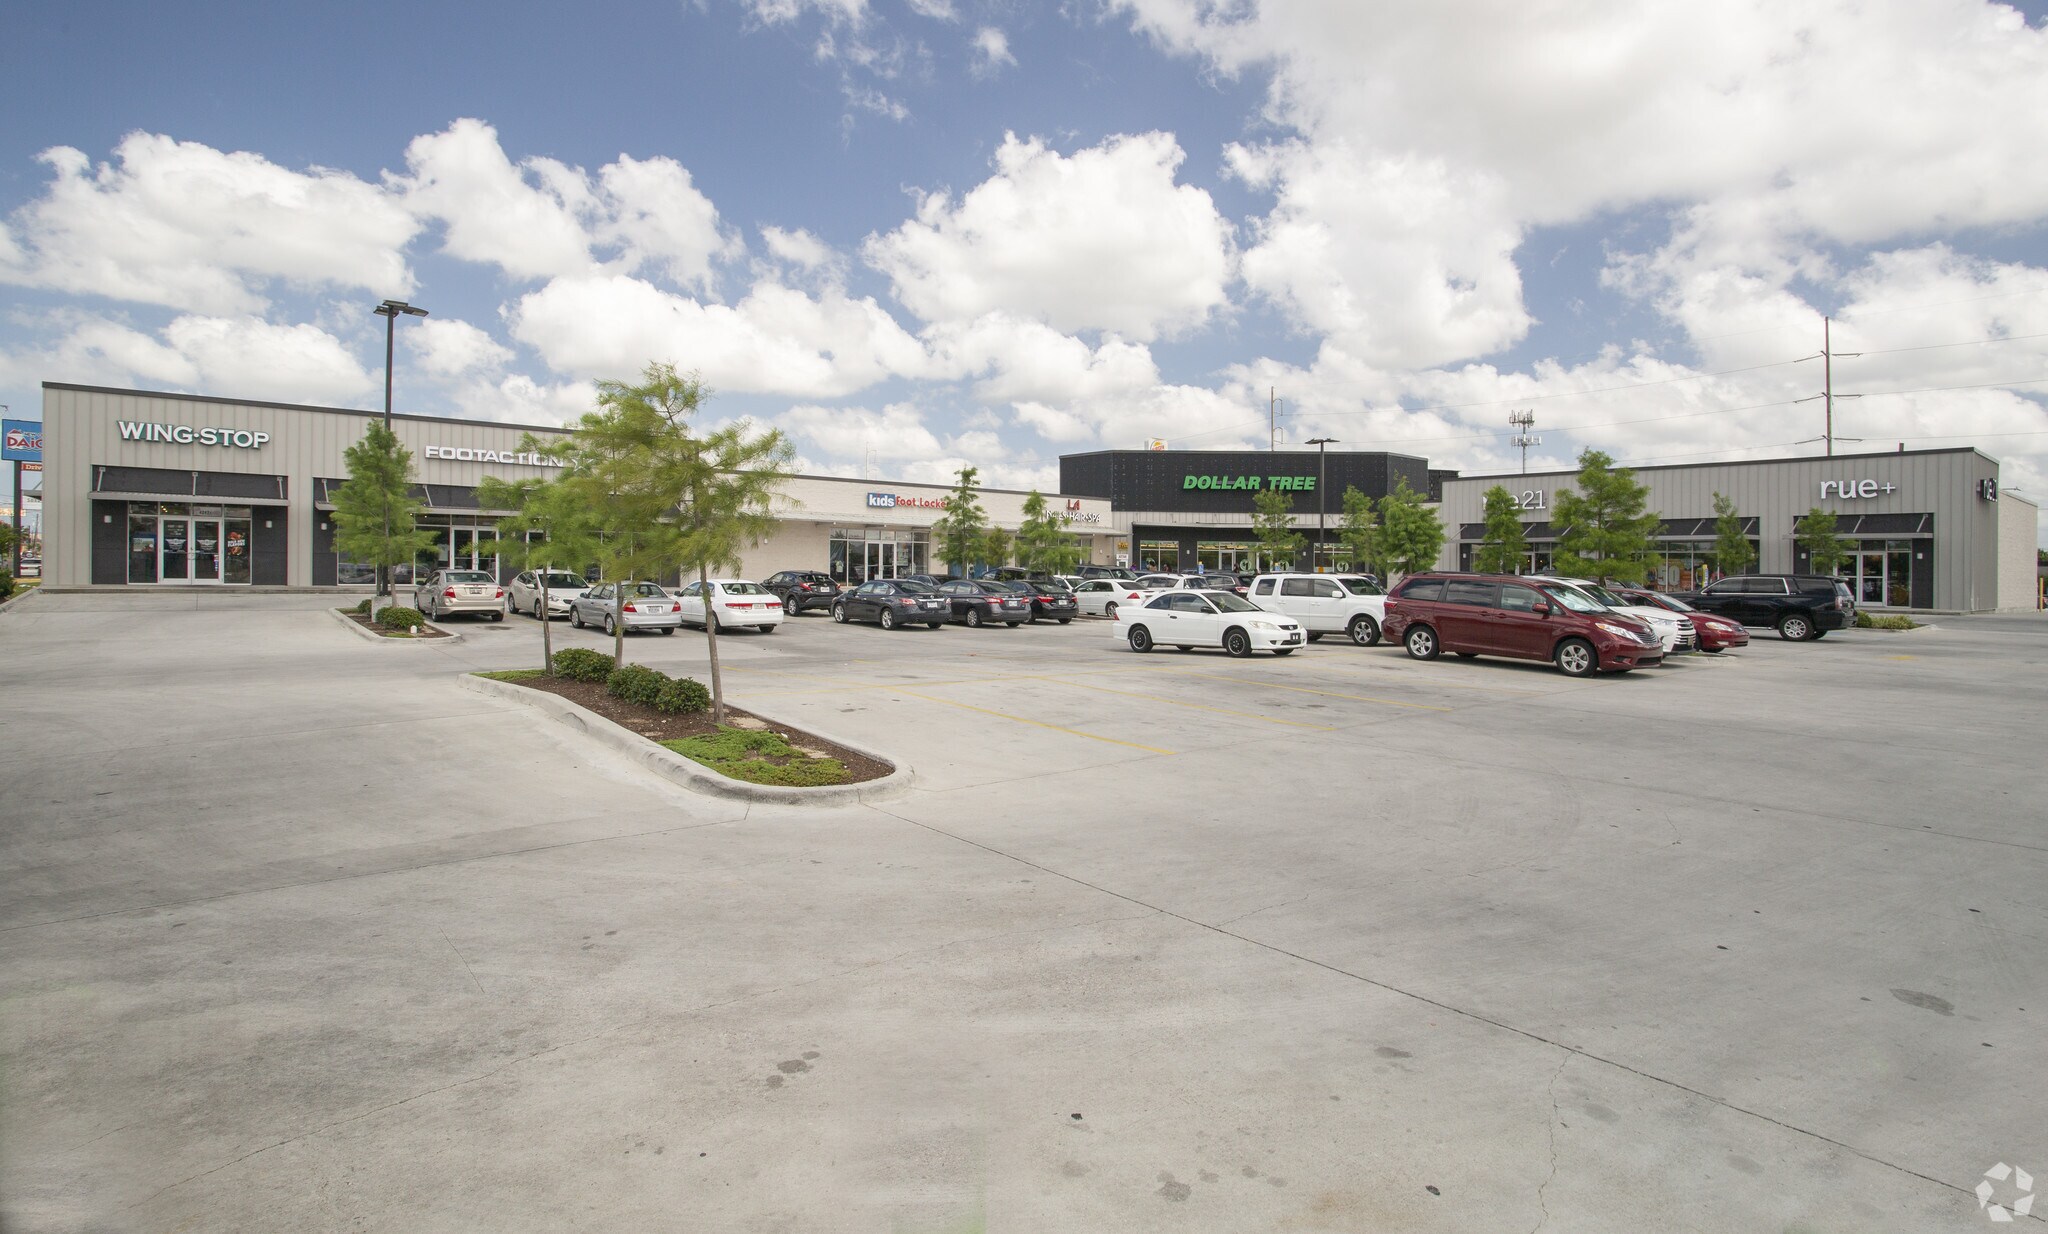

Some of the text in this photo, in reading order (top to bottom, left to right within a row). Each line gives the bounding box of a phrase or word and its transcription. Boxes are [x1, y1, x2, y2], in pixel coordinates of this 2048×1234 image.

[425, 445, 564, 467] FOOTACTION
[1183, 475, 1317, 490] DOLLAR TREE
[869, 493, 895, 507] kids
[896, 496, 917, 507] Foot
[1066, 499, 1080, 510] LA
